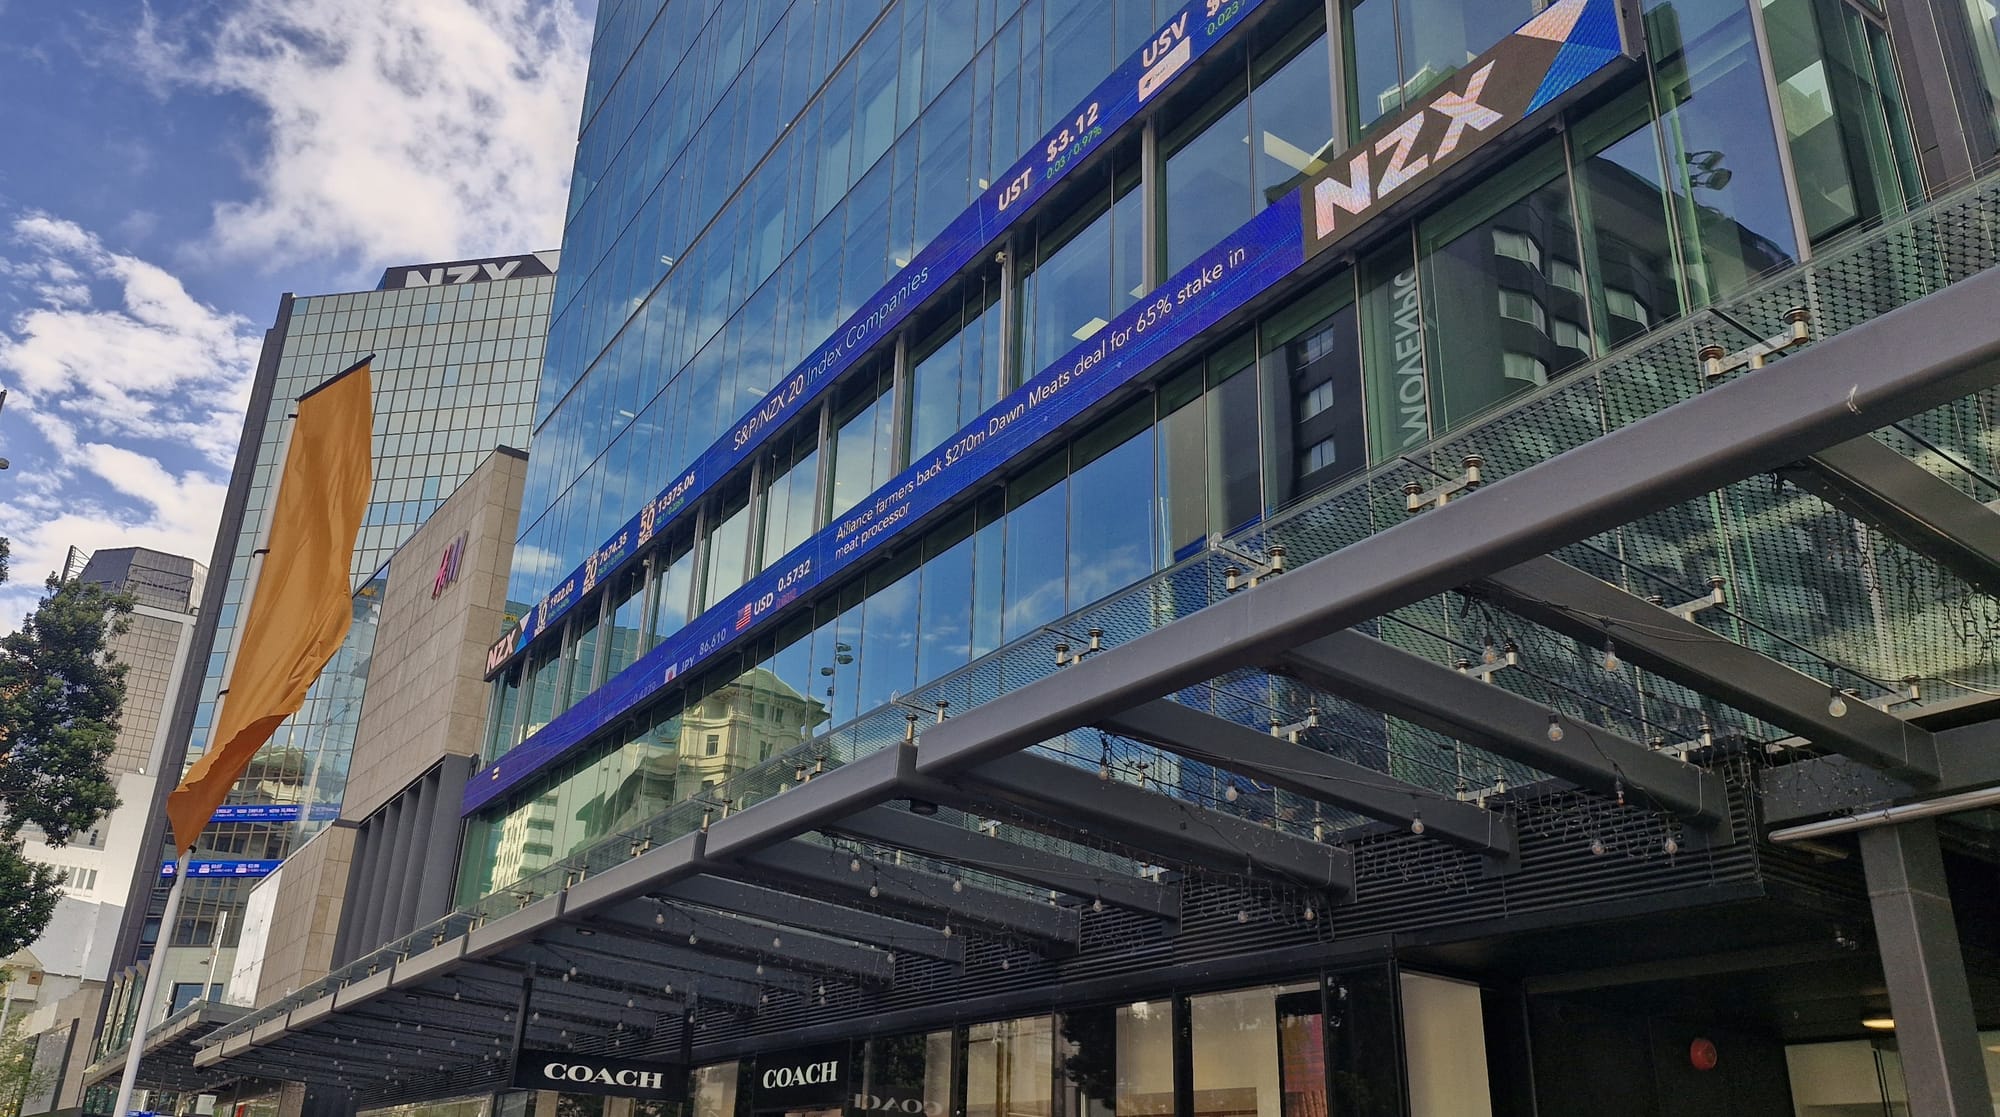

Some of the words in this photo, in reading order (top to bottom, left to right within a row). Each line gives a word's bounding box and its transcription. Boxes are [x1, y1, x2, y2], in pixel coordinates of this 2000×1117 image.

[1142, 11, 1188, 68] USV
[1046, 102, 1098, 162] $3.12
[1314, 59, 1504, 240] NZX
[998, 167, 1032, 212] UST
[733, 394, 785, 451] S&P/NZX
[788, 374, 804, 404] 20
[806, 343, 842, 387] Index
[846, 266, 929, 349] Companies
[835, 509, 873, 542] Alliance
[875, 481, 914, 515] farmers
[917, 457, 942, 487] back
[945, 432, 985, 467] $270m
[989, 405, 1024, 436] Dawn
[1028, 371, 1070, 407] Meats
[1074, 340, 1106, 376] deal
[1110, 325, 1133, 351] for
[1136, 294, 1172, 333] 65%
[1177, 263, 1223, 305] stake
[1228, 247, 1245, 269] in
[639, 508, 655, 537] 50
[835, 540, 860, 561] meat
[861, 501, 911, 547] processor
[754, 592, 773, 616] USD
[485, 628, 517, 675] NZX
[543, 1062, 664, 1089] COACH
[762, 1060, 839, 1089] COACH
